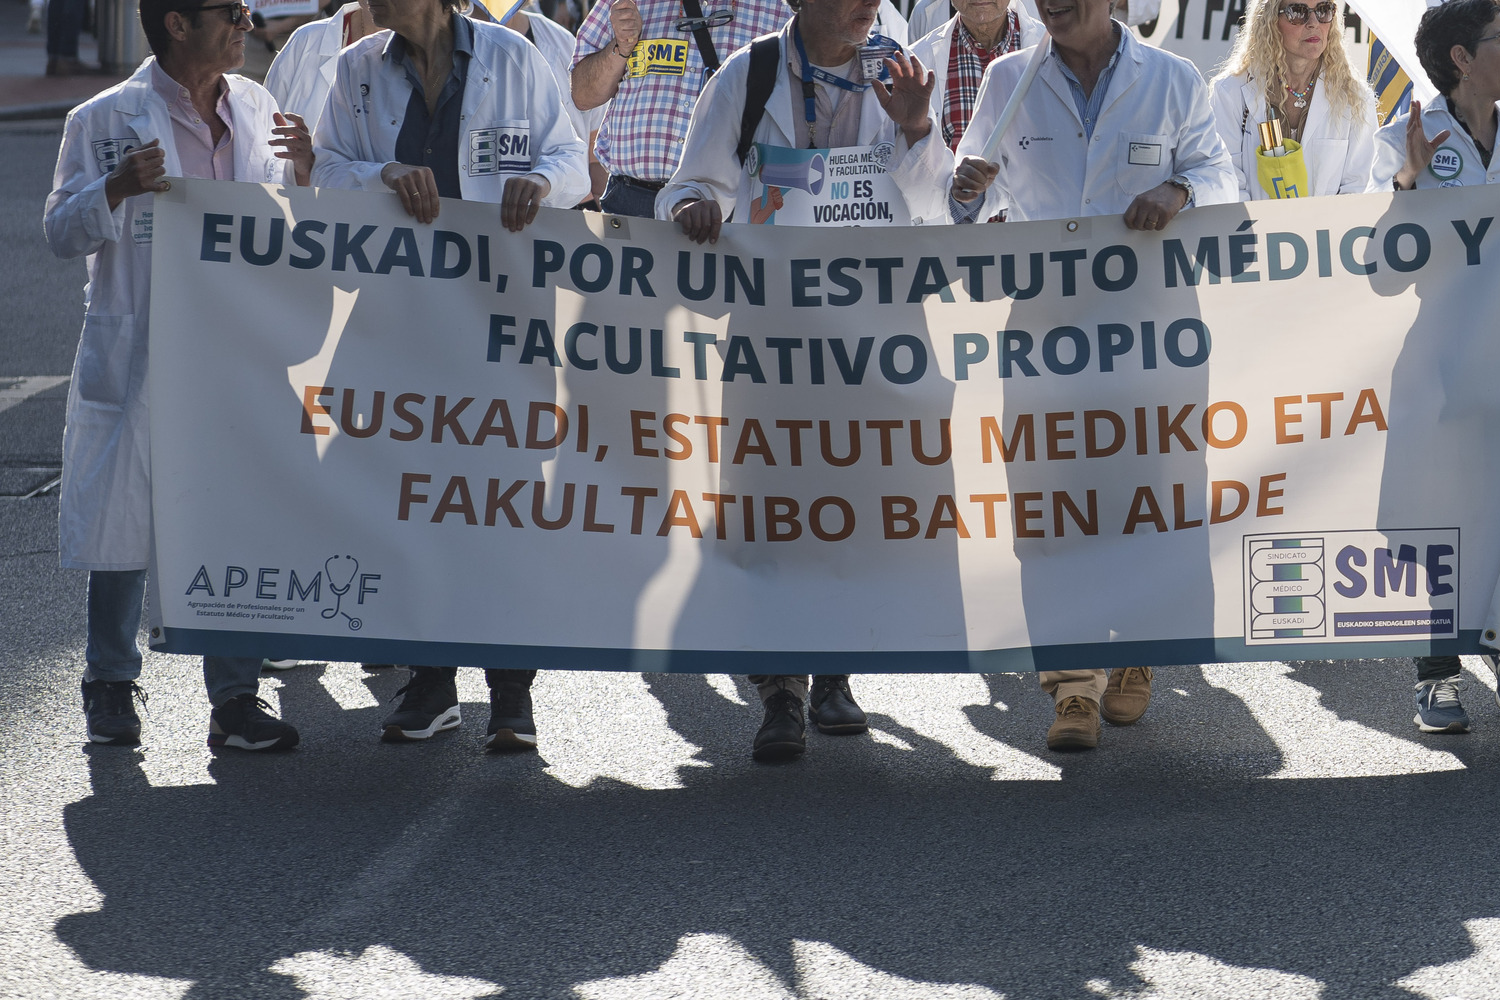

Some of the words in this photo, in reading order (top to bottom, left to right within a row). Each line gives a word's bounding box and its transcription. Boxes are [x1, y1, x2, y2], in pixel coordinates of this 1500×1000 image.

[648, 43, 687, 62] SME
[829, 153, 859, 166] HUELGA
[1434, 154, 1458, 166] SME
[829, 167, 835, 177] Y
[831, 181, 849, 200] NO
[853, 179, 873, 199] ES
[813, 198, 894, 223] VOCACIÓN,
[199, 212, 509, 294] EUSKADI,
[532, 238, 658, 298] POR
[676, 250, 766, 307] UN
[790, 243, 1140, 307] ESTATUTO
[1162, 220, 1432, 289] MÉDICO
[1450, 216, 1495, 266] Y
[486, 313, 928, 386] FACULTATIVO
[952, 317, 1213, 381] PROPIO
[300, 384, 610, 463] EUSKADI,
[629, 410, 953, 468] ESTATUTU
[979, 400, 1249, 465] MEDIKO
[1273, 387, 1390, 446] ETA
[397, 472, 857, 543] FAKULTATIBO
[881, 489, 1100, 541] BATEN
[1121, 472, 1288, 536] ALDE
[1267, 551, 1307, 560] SINDICATO
[1333, 544, 1455, 599] SME
[1272, 582, 1303, 593] MÉDICO
[187, 600, 226, 610] Agrupación
[236, 603, 282, 611] Profesionales
[196, 609, 225, 617] Estatuto
[226, 611, 250, 619] Médico
[257, 612, 295, 621] Facultativo
[1272, 617, 1305, 626] EUSKADI
[1337, 620, 1374, 628] EUSKADIKO
[1375, 619, 1416, 627] SENDAGILEEN
[1417, 618, 1452, 626] SINDIKATUA
